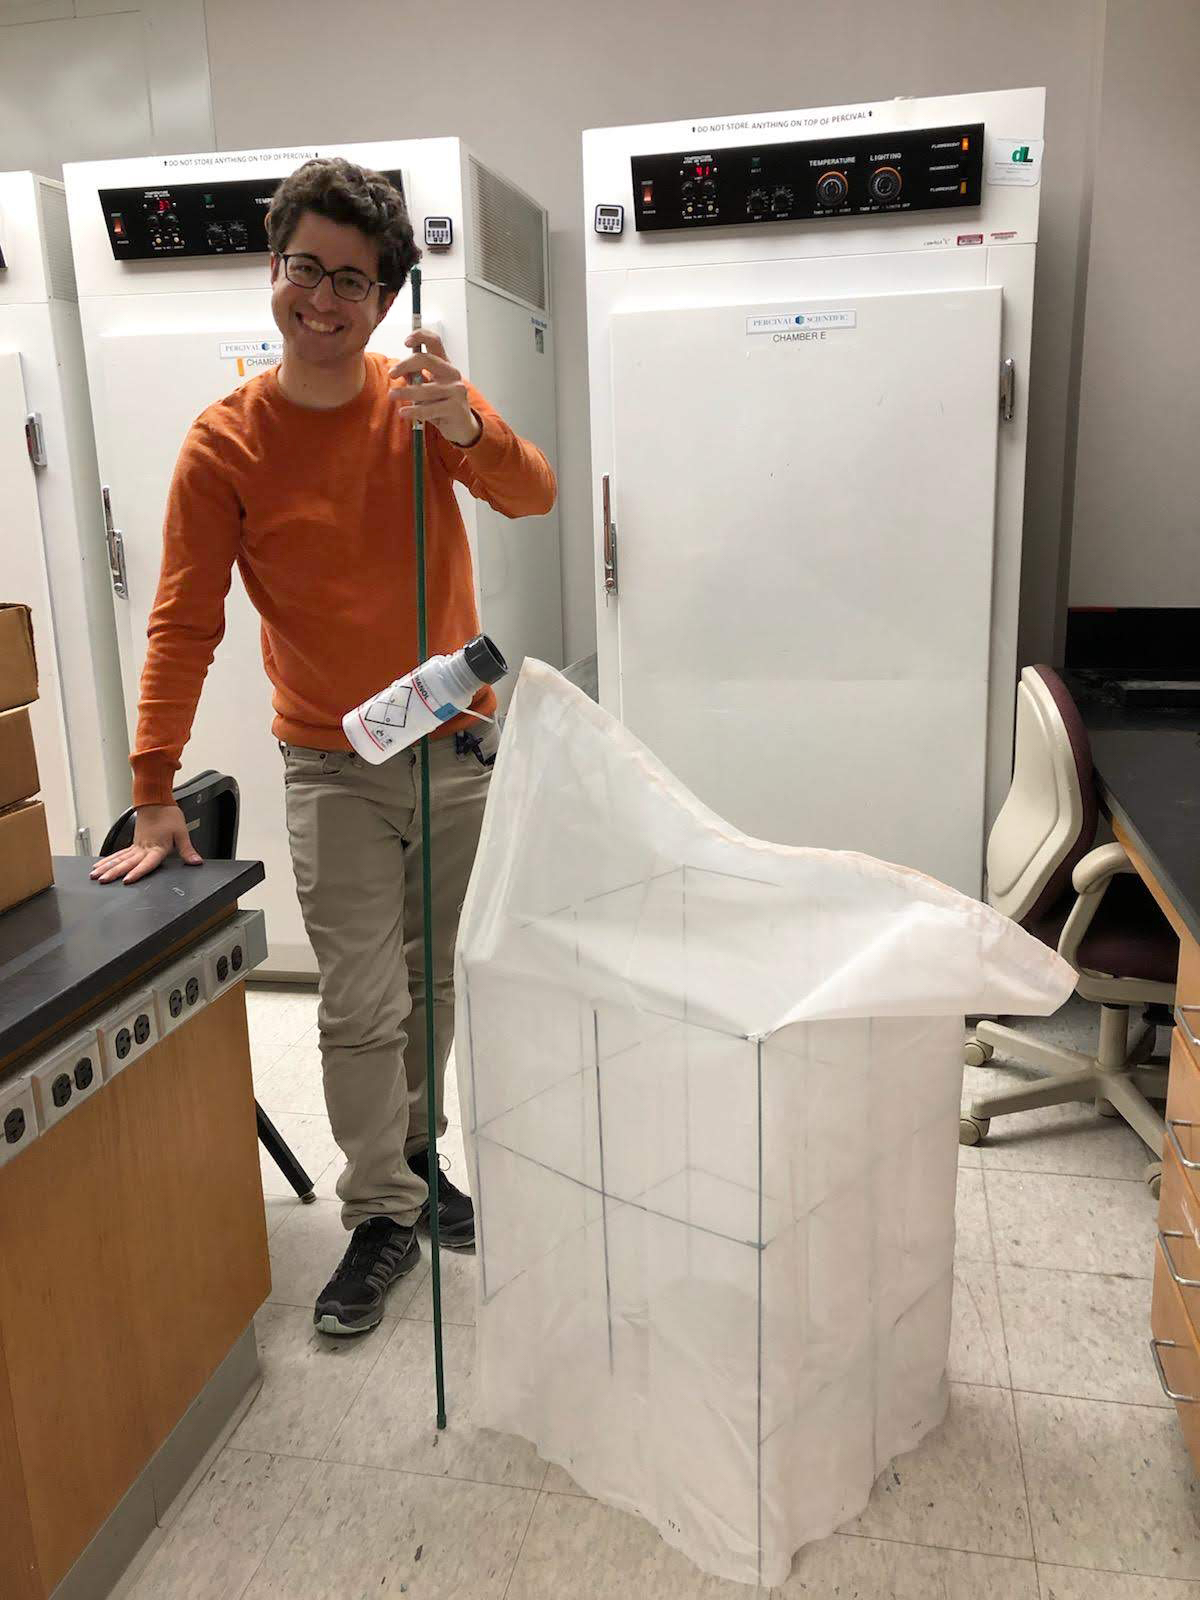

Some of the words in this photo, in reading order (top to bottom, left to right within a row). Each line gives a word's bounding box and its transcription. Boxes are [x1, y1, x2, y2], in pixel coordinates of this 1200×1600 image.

[726, 122, 749, 131] STORE
[751, 120, 789, 129] ANYTHING
[790, 119, 802, 128] ON
[804, 118, 818, 127] TOP
[820, 117, 830, 125] OF
[831, 112, 866, 123] PERCIVAL
[194, 158, 213, 166] STORE
[215, 156, 247, 164] ANYTHING
[283, 152, 312, 160] PERCIVAL
[809, 156, 856, 167] TEMPERATURE
[869, 153, 902, 162] LIGHTING
[753, 317, 793, 326] PERCIVAL
[806, 314, 848, 323] SCIENTIFIC
[773, 332, 818, 343] CHAMBER
[820, 331, 827, 340] E
[225, 344, 259, 352] PERCIVAL
